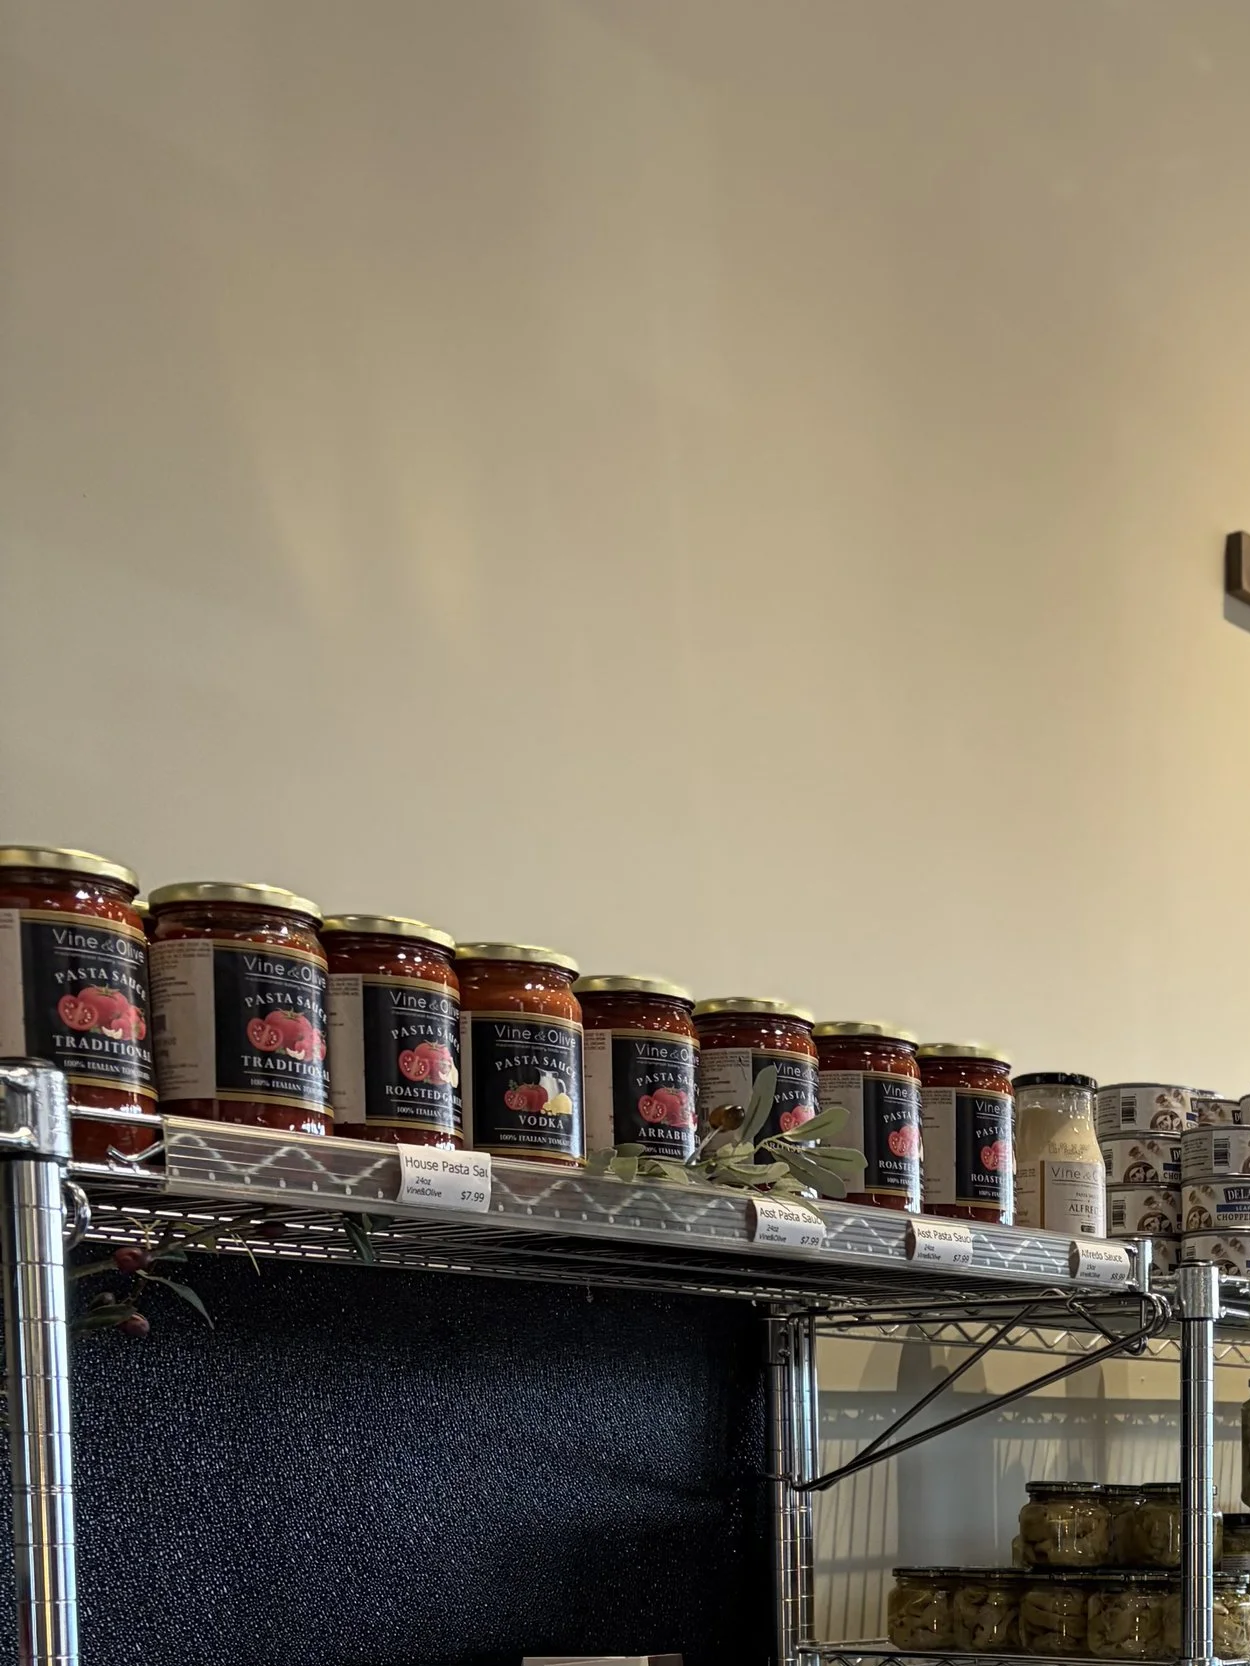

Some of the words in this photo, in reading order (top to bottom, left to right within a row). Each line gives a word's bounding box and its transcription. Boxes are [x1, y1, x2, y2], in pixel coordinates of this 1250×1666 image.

[52, 928, 98, 948] Vine
[116, 939, 144, 963] Olive
[244, 955, 284, 975] Vine
[301, 967, 326, 988] Olive
[54, 968, 107, 983] PASTA
[112, 971, 147, 1000] SAUCE
[244, 993, 293, 1007] PASTA
[389, 991, 426, 1009] Vine
[391, 1025, 432, 1039] PASTA
[495, 1025, 532, 1040] Vine
[548, 1030, 576, 1049] Olive
[52, 1034, 152, 1063] TRADITIONAL
[635, 1043, 668, 1058] Vine
[241, 1055, 331, 1082] TRADITIONAL
[495, 1056, 538, 1071] PASTA
[543, 1057, 576, 1078] SAUCE
[637, 1073, 673, 1086] PASTA
[385, 1085, 440, 1100] ROASTED
[882, 1083, 908, 1098] Vine
[976, 1100, 1001, 1113] Vine
[518, 1115, 564, 1129] VODKA
[405, 1157, 438, 1171] House
[442, 1162, 469, 1176] Pasta
[1050, 1166, 1082, 1180] Vine
[416, 1177, 431, 1186] 24oz
[461, 1192, 484, 1202] $7.99
[760, 1208, 777, 1219] Asst
[779, 1209, 800, 1222] Pasta
[801, 1236, 819, 1246] $7.99
[918, 1228, 931, 1239] Asst
[932, 1230, 951, 1242] Pasta
[953, 1252, 970, 1263] $7.99
[1081, 1250, 1104, 1261] Alfredo
[1105, 1252, 1123, 1262] Sauce
